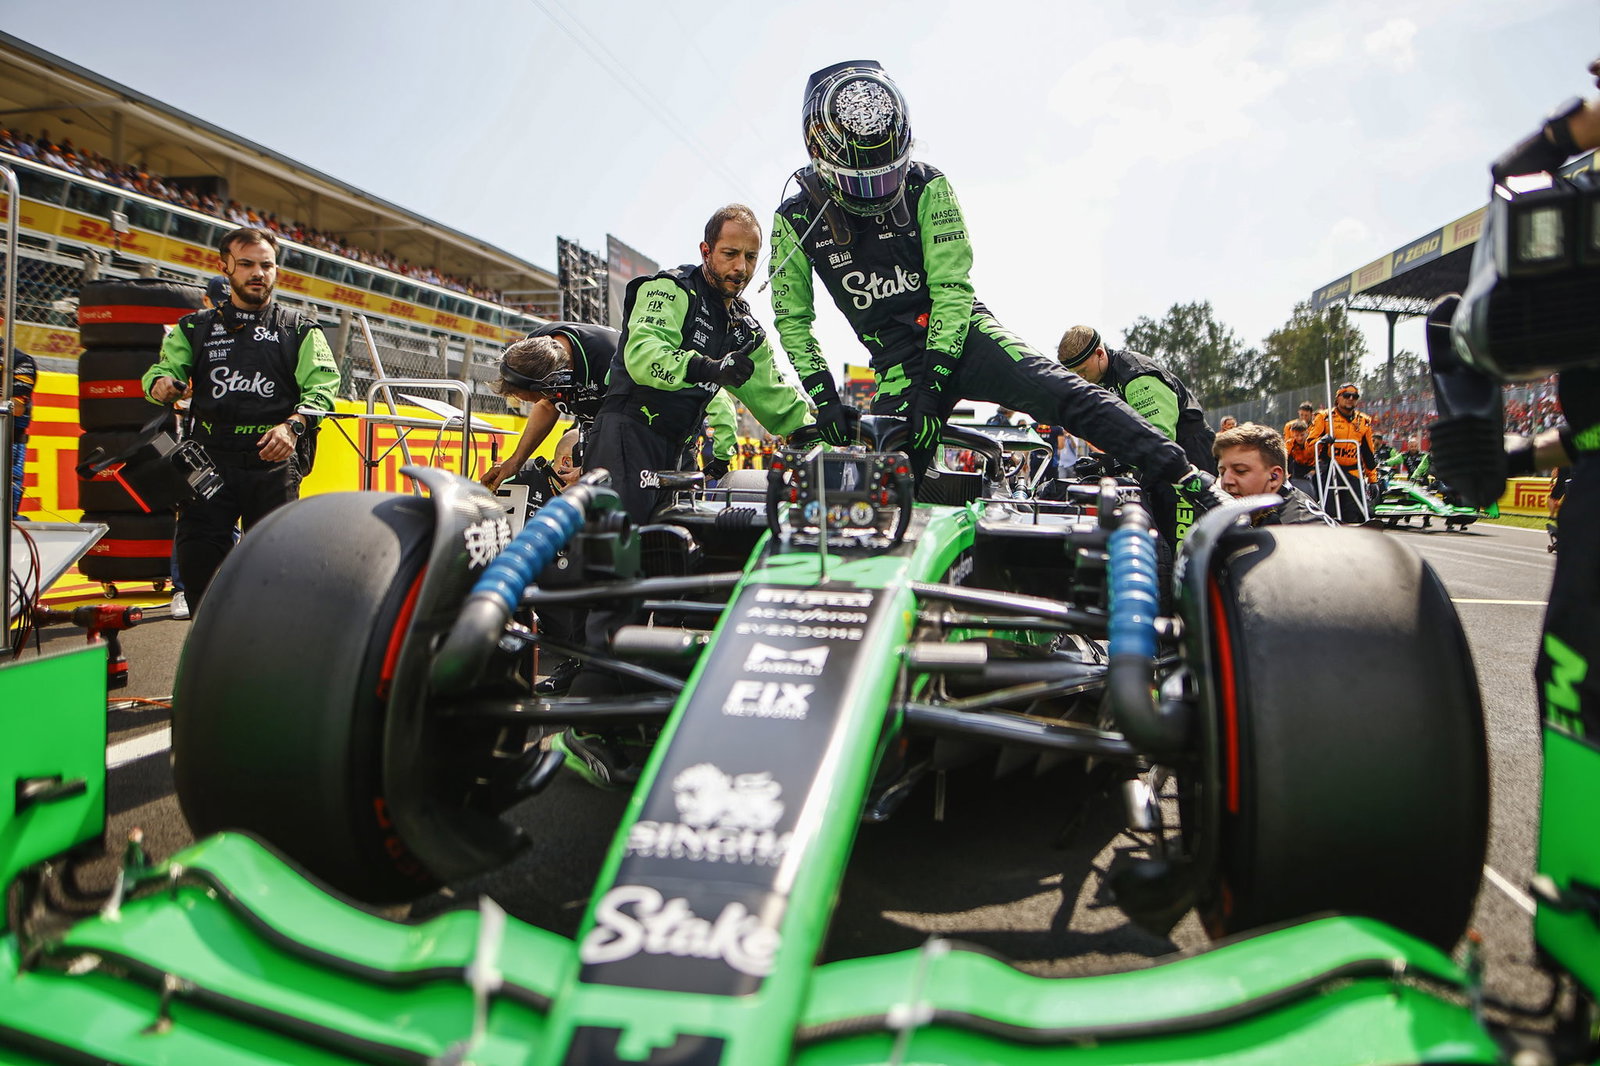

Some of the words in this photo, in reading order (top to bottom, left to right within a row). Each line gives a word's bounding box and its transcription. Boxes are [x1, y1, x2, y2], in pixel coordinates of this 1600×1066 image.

[931, 209, 960, 221] MASCOT
[933, 230, 965, 244] PIRELLI
[1404, 235, 1441, 264] ZERO
[646, 289, 676, 302] Hyland
[841, 265, 921, 311] Stake
[647, 300, 664, 310] FIX
[253, 326, 280, 344] Stak
[209, 366, 276, 400] Stake
[651, 362, 688, 385] Stake
[234, 426, 256, 434] PIT
[1514, 483, 1554, 508] PIRE
[724, 680, 816, 711] FIX
[579, 885, 782, 977] Stake
